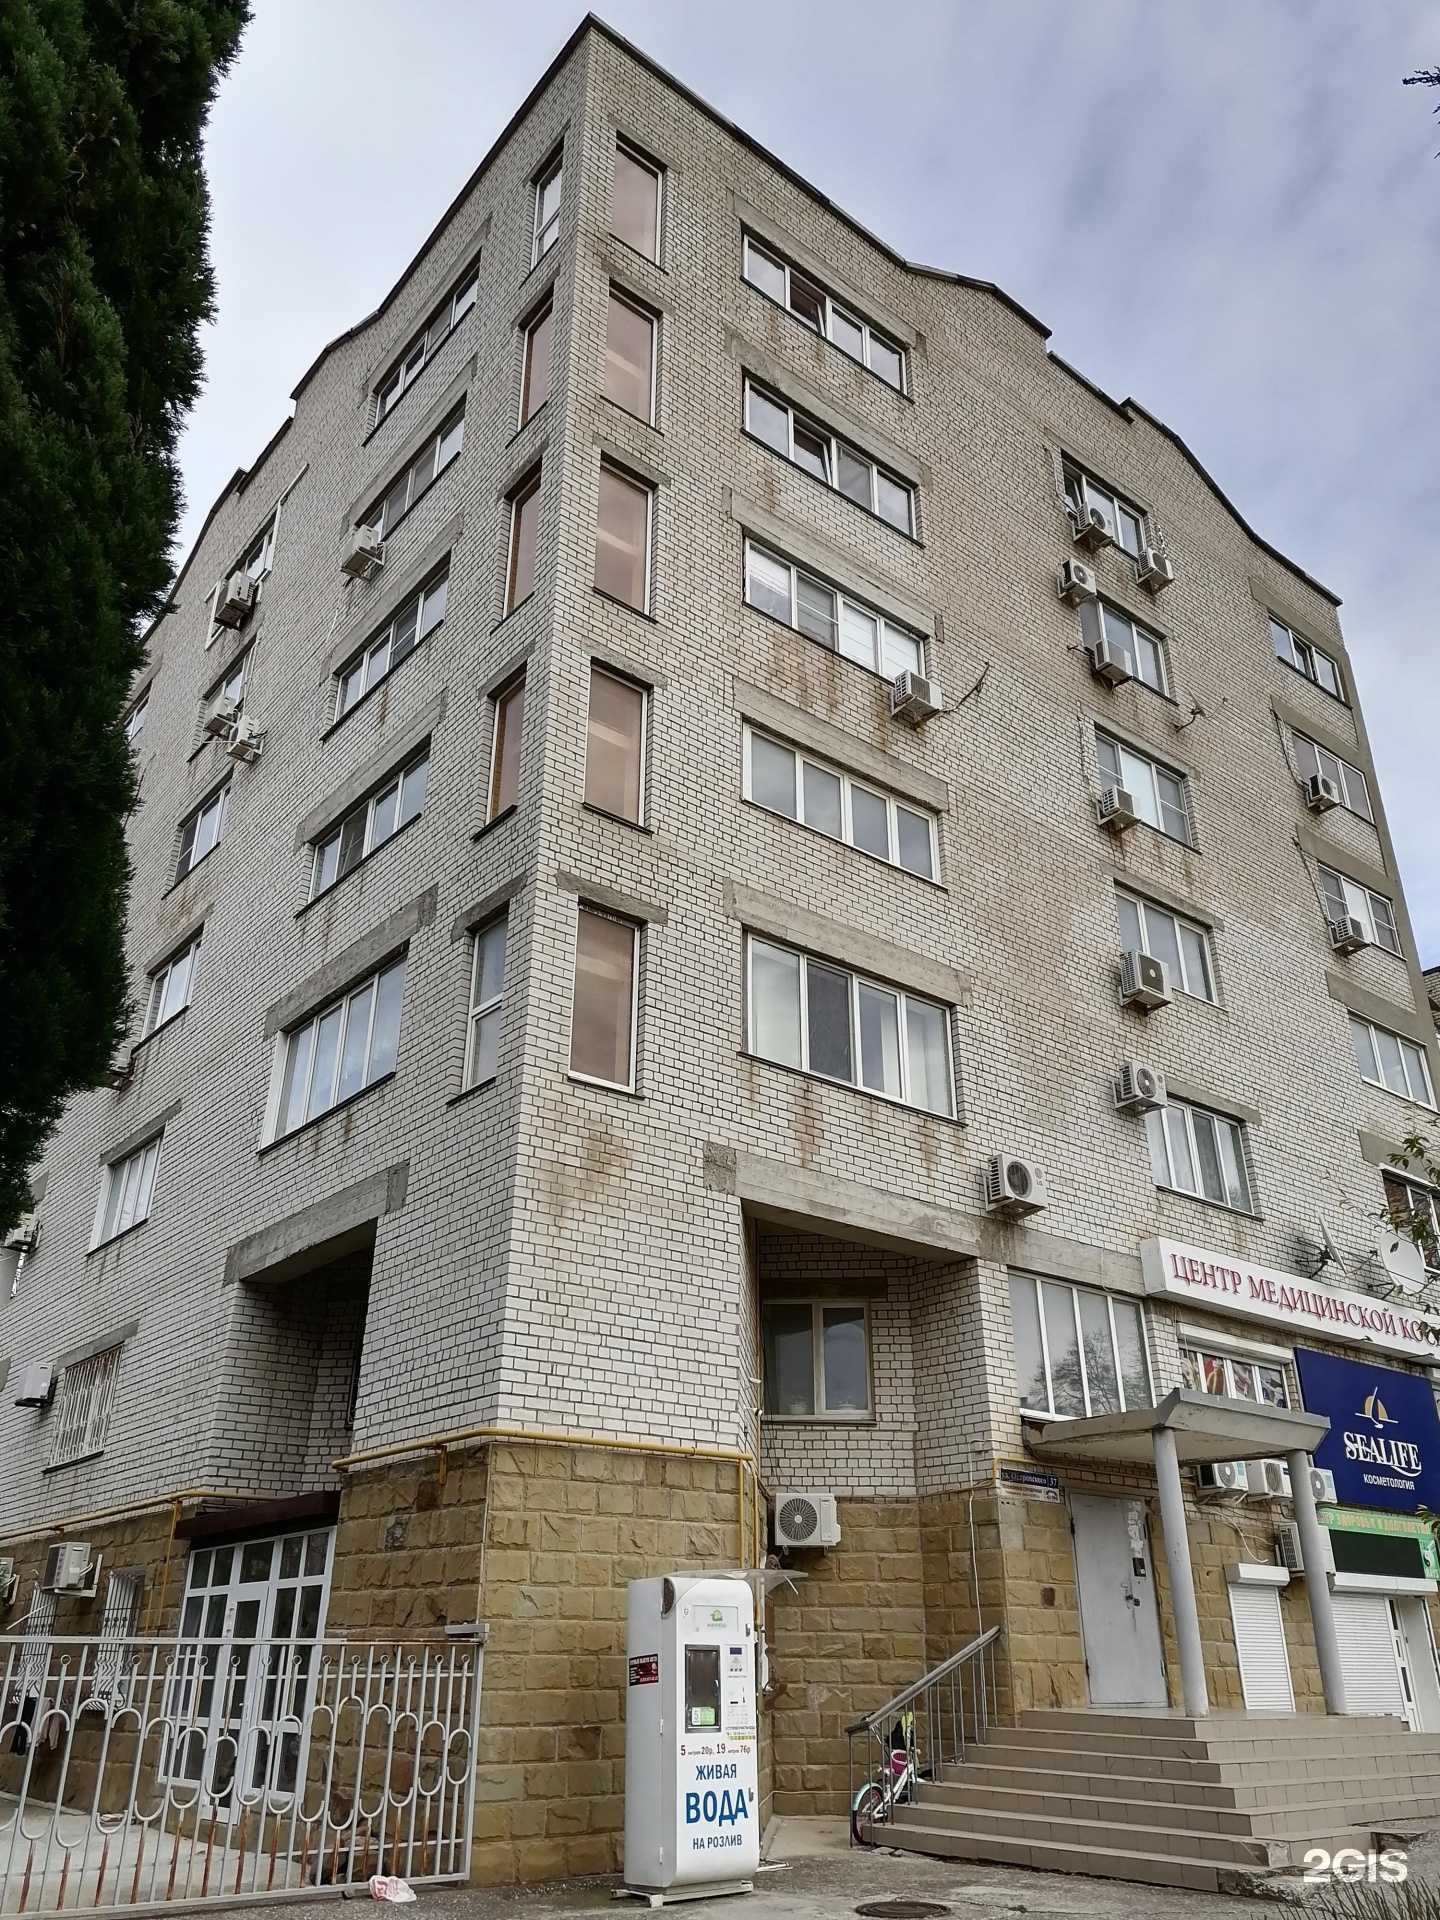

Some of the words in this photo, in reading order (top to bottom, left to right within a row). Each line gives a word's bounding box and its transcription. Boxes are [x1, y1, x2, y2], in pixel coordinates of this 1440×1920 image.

[1170, 1253, 1242, 1295] ЦЕНТР
[1247, 1275, 1398, 1336] МЕДИЦИНСКОЙ
[1343, 1431, 1422, 1471] SEALIFE
[1363, 1473, 1415, 1490] КОСМЕТОЛОГИЯ
[680, 1744, 686, 1756] 5
[716, 1743, 726, 1754] 19
[695, 1763, 737, 1781] ЖИВАЯ
[685, 1788, 749, 1827] ВОДА
[692, 1836, 705, 1850] НА
[707, 1834, 743, 1849] РОЗЛИВ
